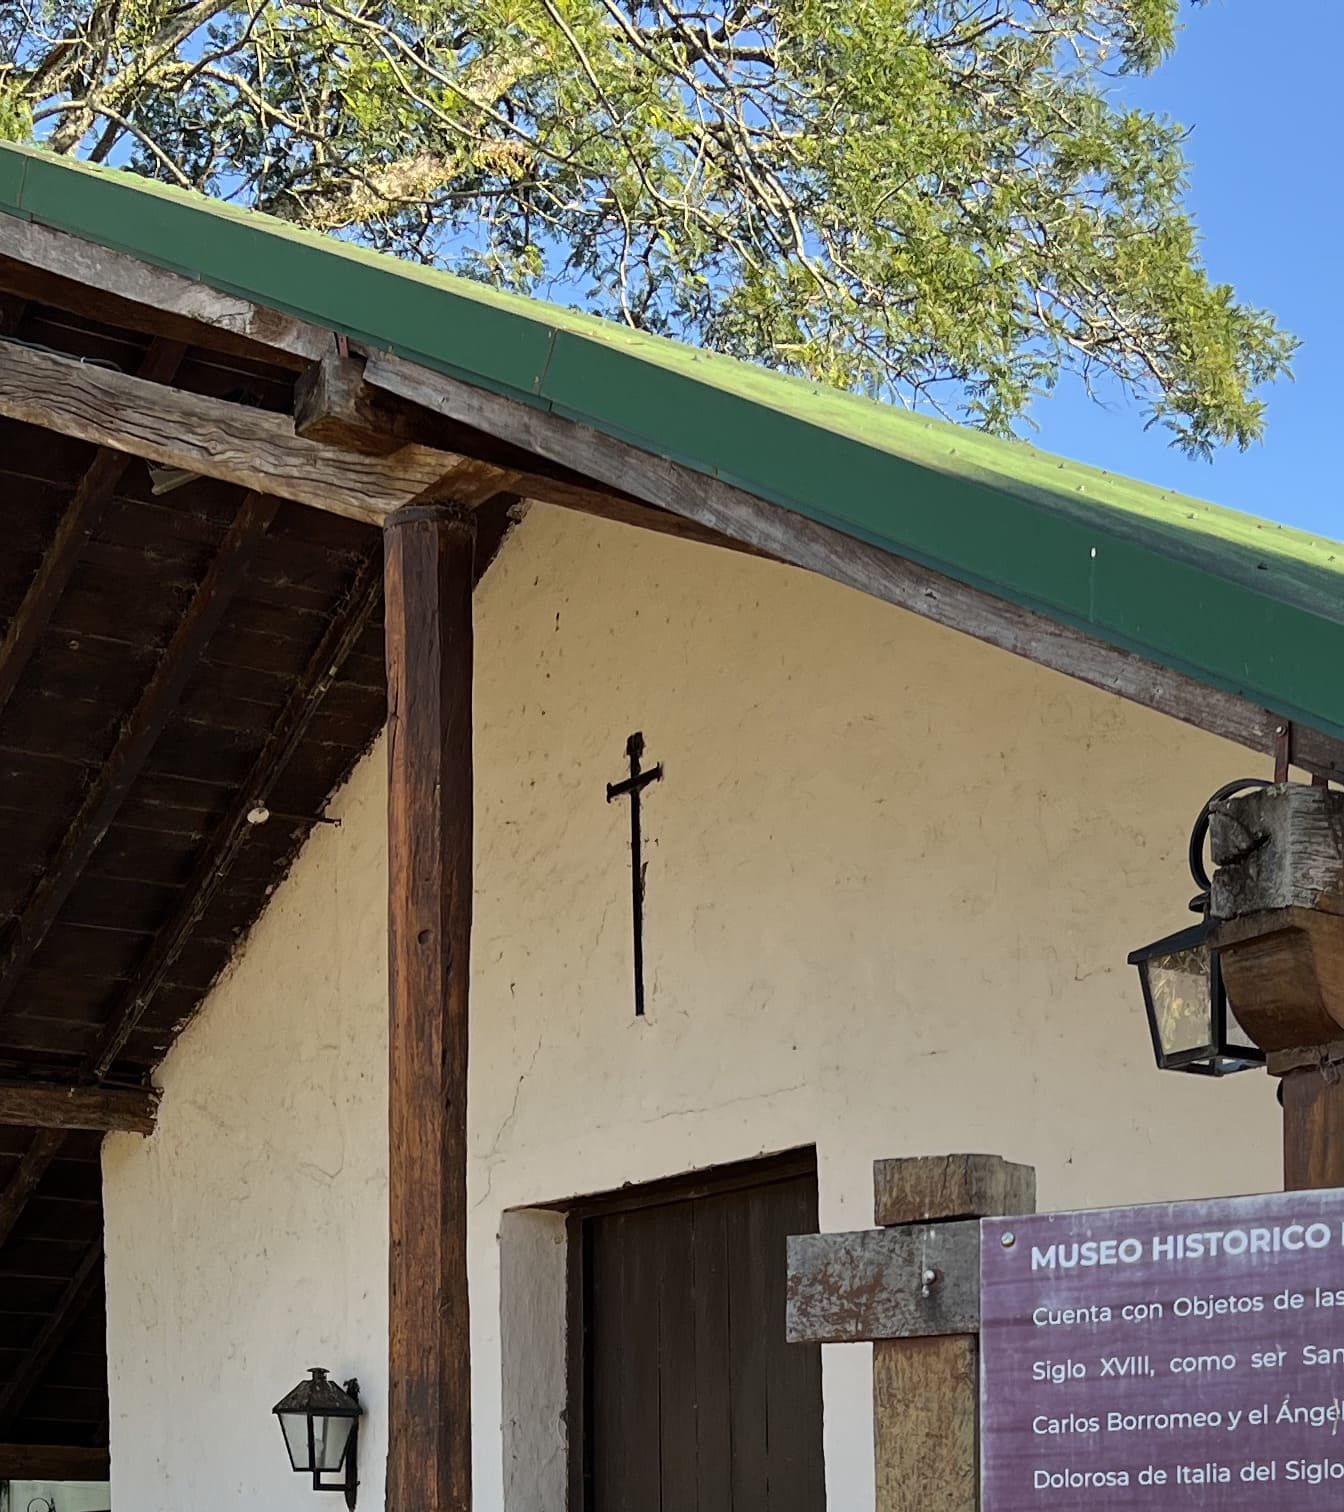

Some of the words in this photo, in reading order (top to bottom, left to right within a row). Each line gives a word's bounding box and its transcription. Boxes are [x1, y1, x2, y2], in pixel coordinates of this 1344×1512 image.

[1032, 1238, 1142, 1271] MUSEO
[1153, 1223, 1330, 1261] HISTORICO
[1033, 1304, 1111, 1328] Cuenta
[1122, 1302, 1162, 1324] con
[1173, 1294, 1264, 1320] Objetos
[1274, 1288, 1304, 1310] de
[1032, 1358, 1086, 1385] Siglo
[1100, 1354, 1154, 1378] XVIII,
[1170, 1354, 1236, 1374] como
[1251, 1348, 1287, 1368] ser
[1033, 1413, 1100, 1435] Carlos
[1108, 1410, 1221, 1431] Borromeo
[1227, 1410, 1242, 1432] y
[1248, 1403, 1268, 1425] el
[1276, 1399, 1344, 1427] Ángel
[1034, 1467, 1129, 1490] Dolorosa
[1138, 1464, 1167, 1486] de
[1177, 1462, 1231, 1485] Italia
[1240, 1460, 1276, 1482] del
[1285, 1458, 1344, 1485] Siglo
